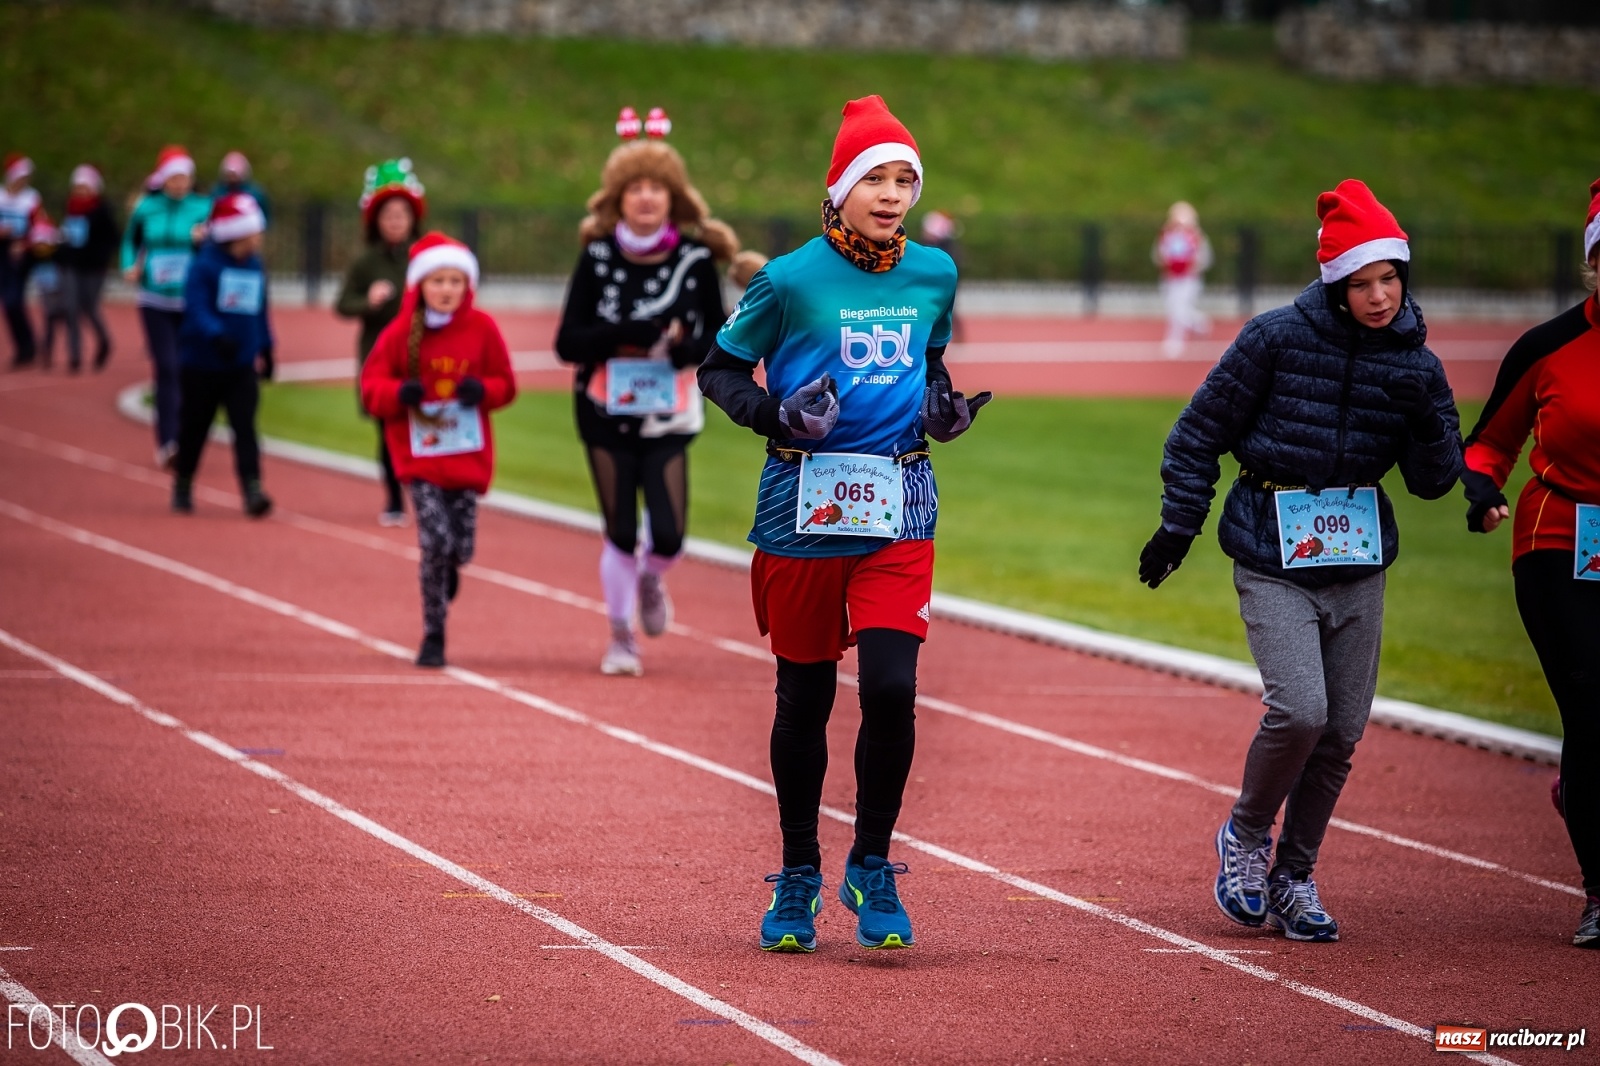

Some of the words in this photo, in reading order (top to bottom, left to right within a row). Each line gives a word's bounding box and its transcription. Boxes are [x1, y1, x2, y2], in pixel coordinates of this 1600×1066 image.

[840, 306, 918, 320] BiegamBoLubię
[840, 323, 914, 368] bbl
[811, 467, 836, 478] Bieg
[834, 481, 875, 502] 065
[1287, 503, 1312, 514] Bieg
[1314, 515, 1350, 534] 099
